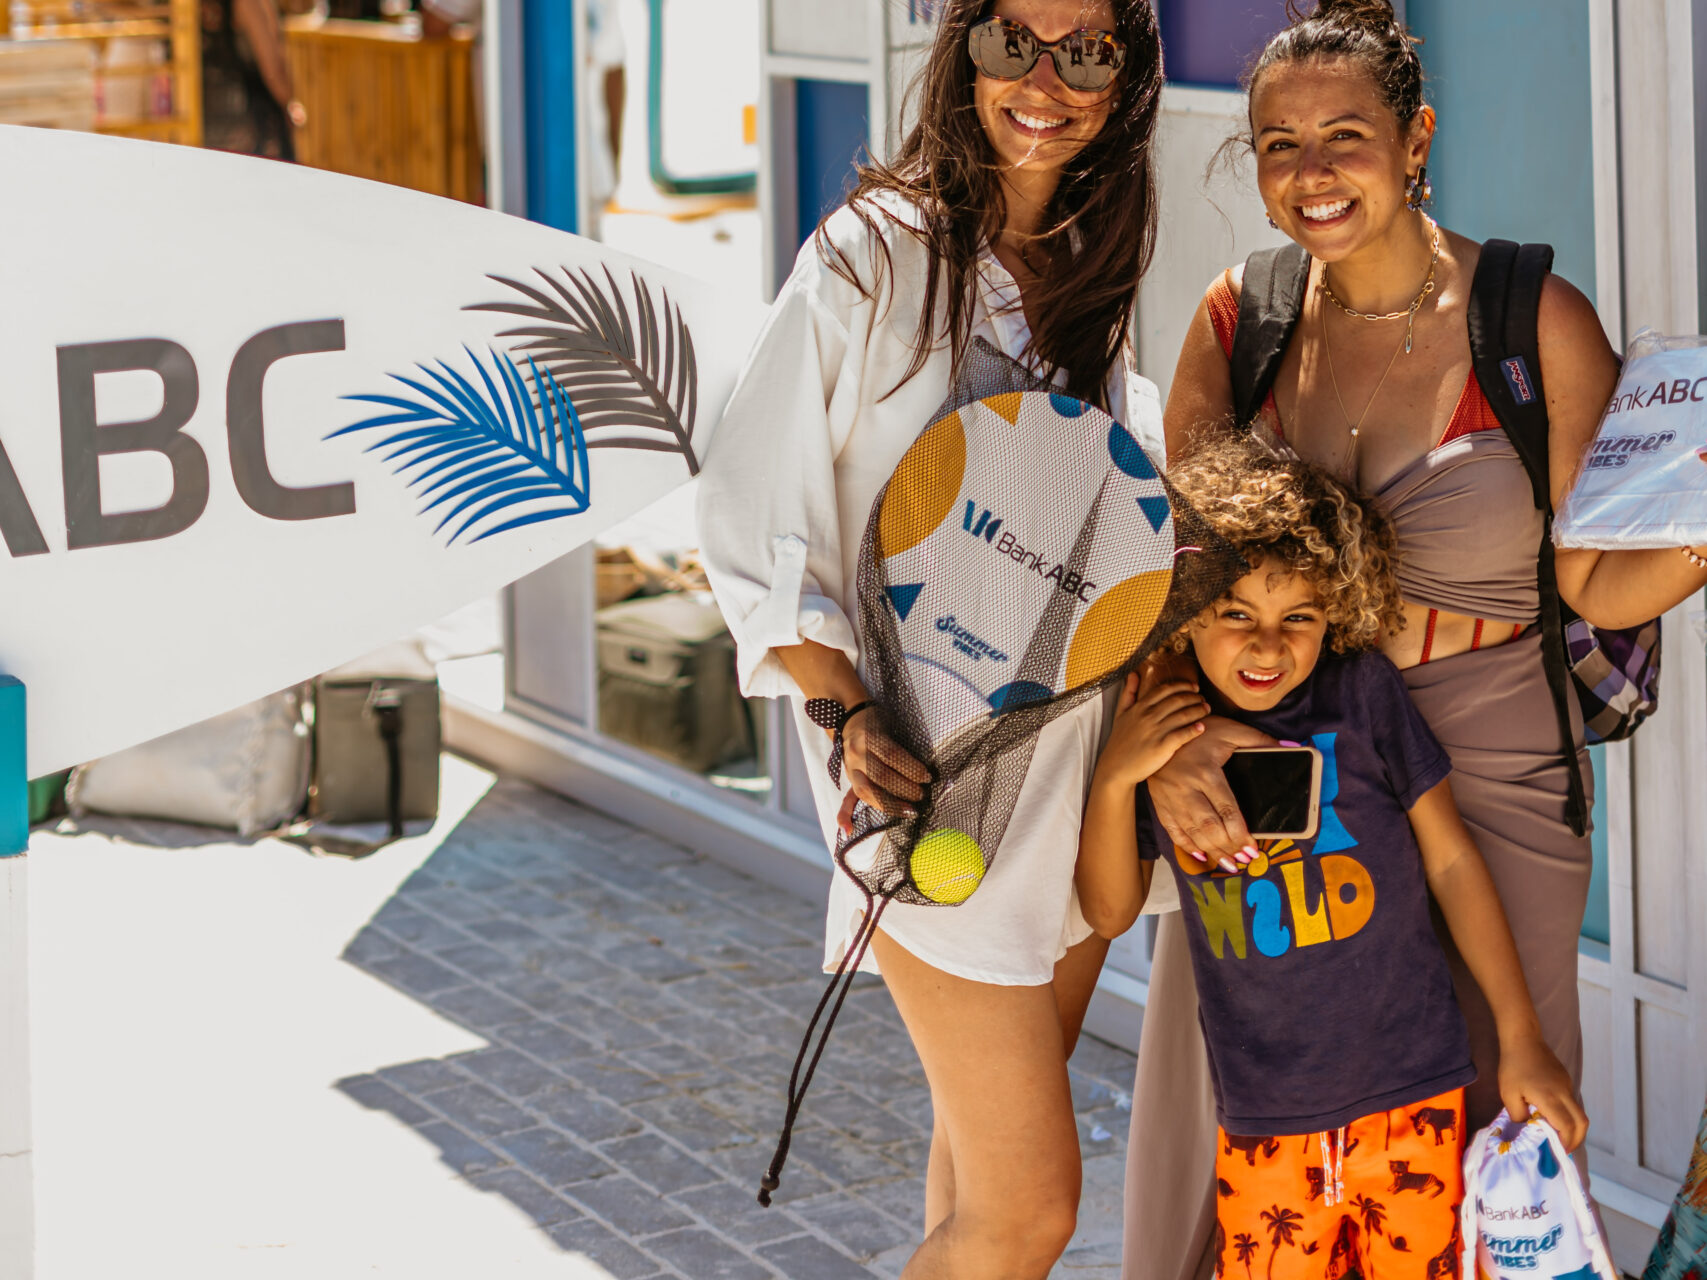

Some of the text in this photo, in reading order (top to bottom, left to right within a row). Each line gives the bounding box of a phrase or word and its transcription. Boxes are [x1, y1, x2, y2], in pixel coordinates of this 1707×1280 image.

[1592, 432, 1674, 455] mmer
[1586, 454, 1629, 469] IBES
[1482, 1226, 1562, 1254] mmer
